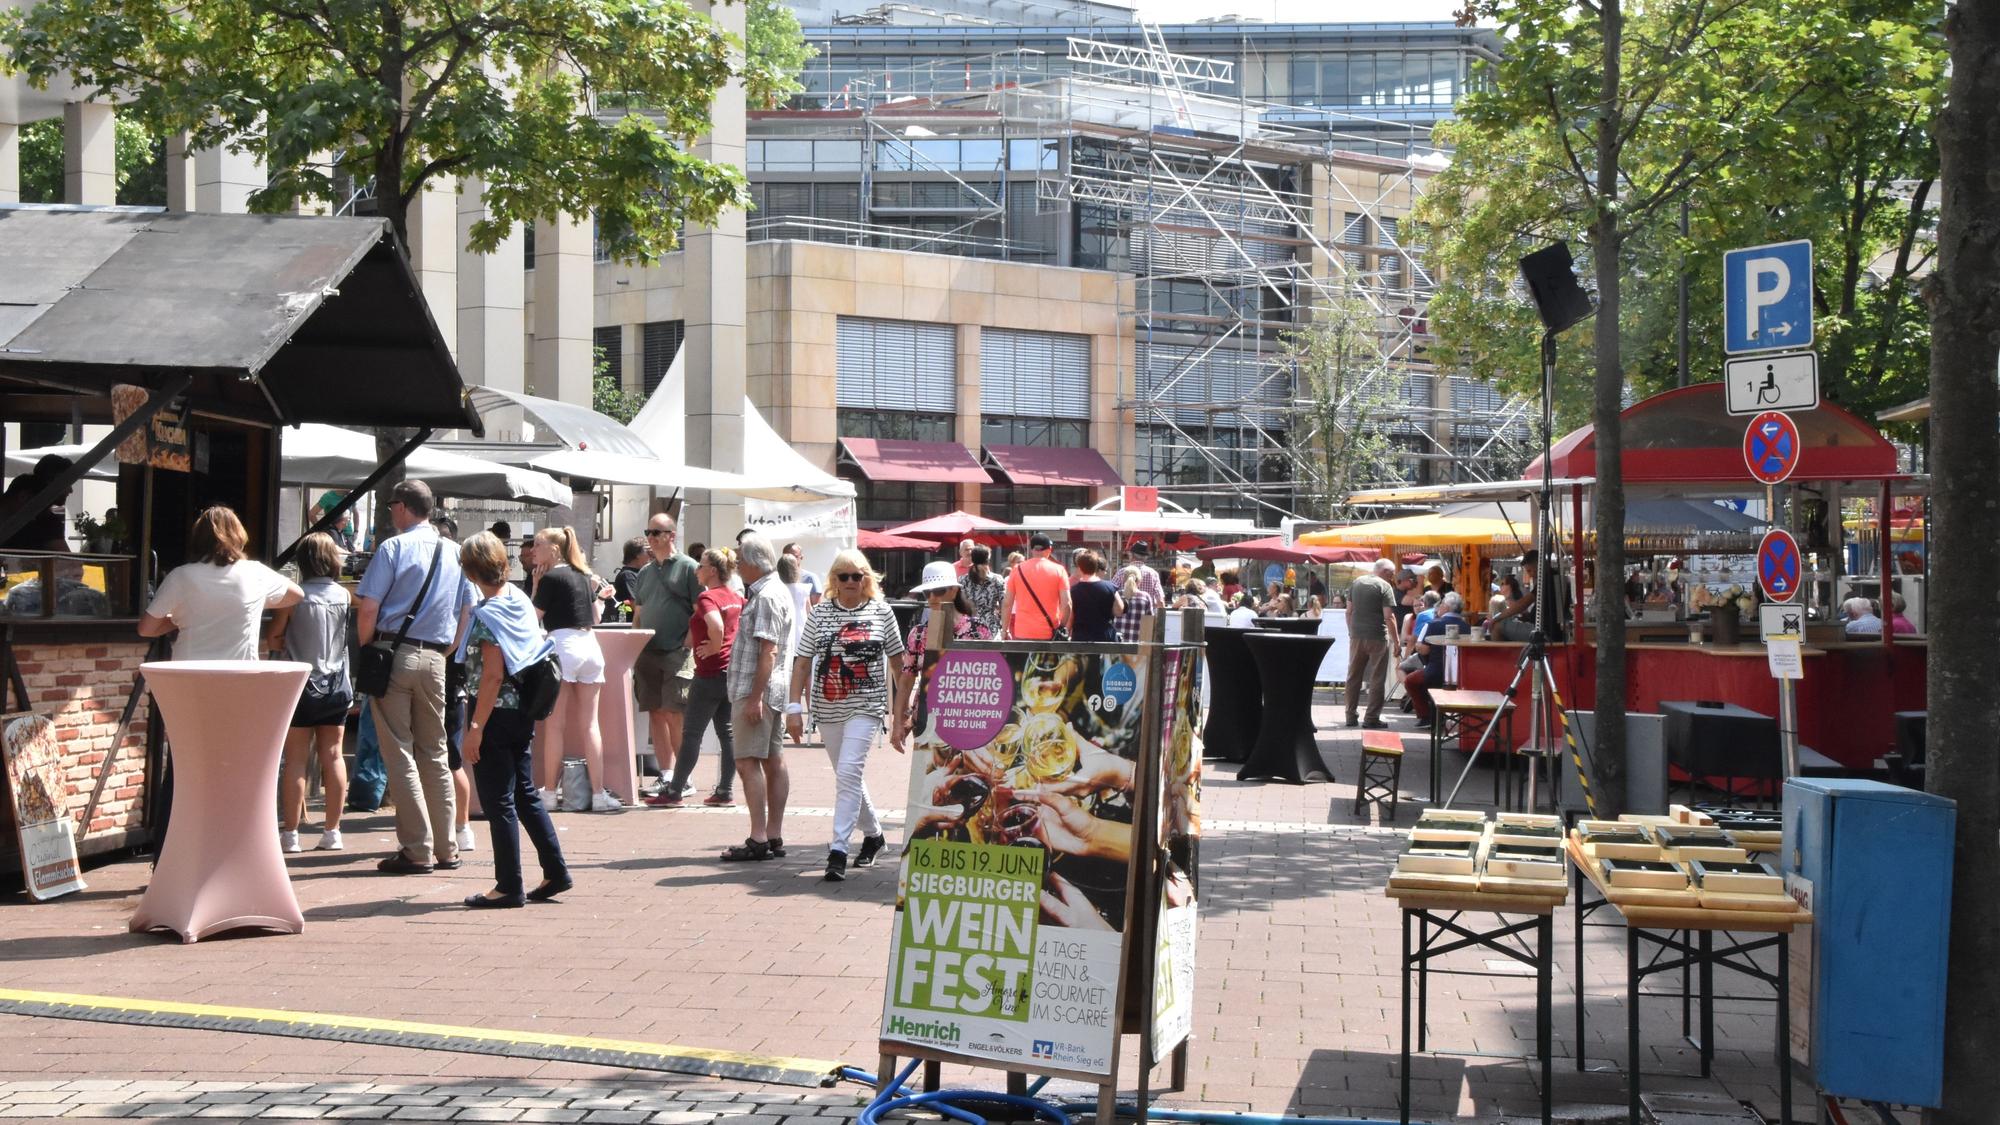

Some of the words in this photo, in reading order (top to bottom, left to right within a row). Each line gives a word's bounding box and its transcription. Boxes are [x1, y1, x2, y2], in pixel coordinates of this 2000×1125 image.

[1746, 257, 1791, 341] P
[1747, 381, 1753, 392] 1
[946, 661, 997, 676] LANGER
[938, 675, 1003, 691] SIEGBURG
[937, 690, 1000, 706] SAMSTAG
[943, 708, 962, 717] JUNI
[964, 709, 1003, 719] SHOPPEN
[943, 719, 956, 728] BIS
[958, 719, 969, 728] 20
[969, 720, 988, 730] UHR
[914, 846, 935, 868] 16.
[941, 849, 966, 871] BIS
[972, 851, 992, 872] 19.
[996, 853, 1039, 876] JUNI
[910, 872, 1037, 902] SIEGBURGER
[908, 897, 1034, 954] WEIN
[1038, 941, 1048, 956] 4
[1053, 941, 1088, 960] TAGE
[900, 947, 1029, 1016] FEST
[1037, 961, 1077, 980] WEIN
[1079, 965, 1089, 982] &
[1034, 981, 1107, 1005] GOURMET
[1032, 1003, 1049, 1020] IM
[1053, 1005, 1108, 1028] S-CARRÉ
[889, 1015, 960, 1041] Henrich
[1055, 1043, 1086, 1054] VR-Bank
[1054, 1052, 1092, 1066] Rhein-Sieg
[1093, 1058, 1104, 1067] eG
